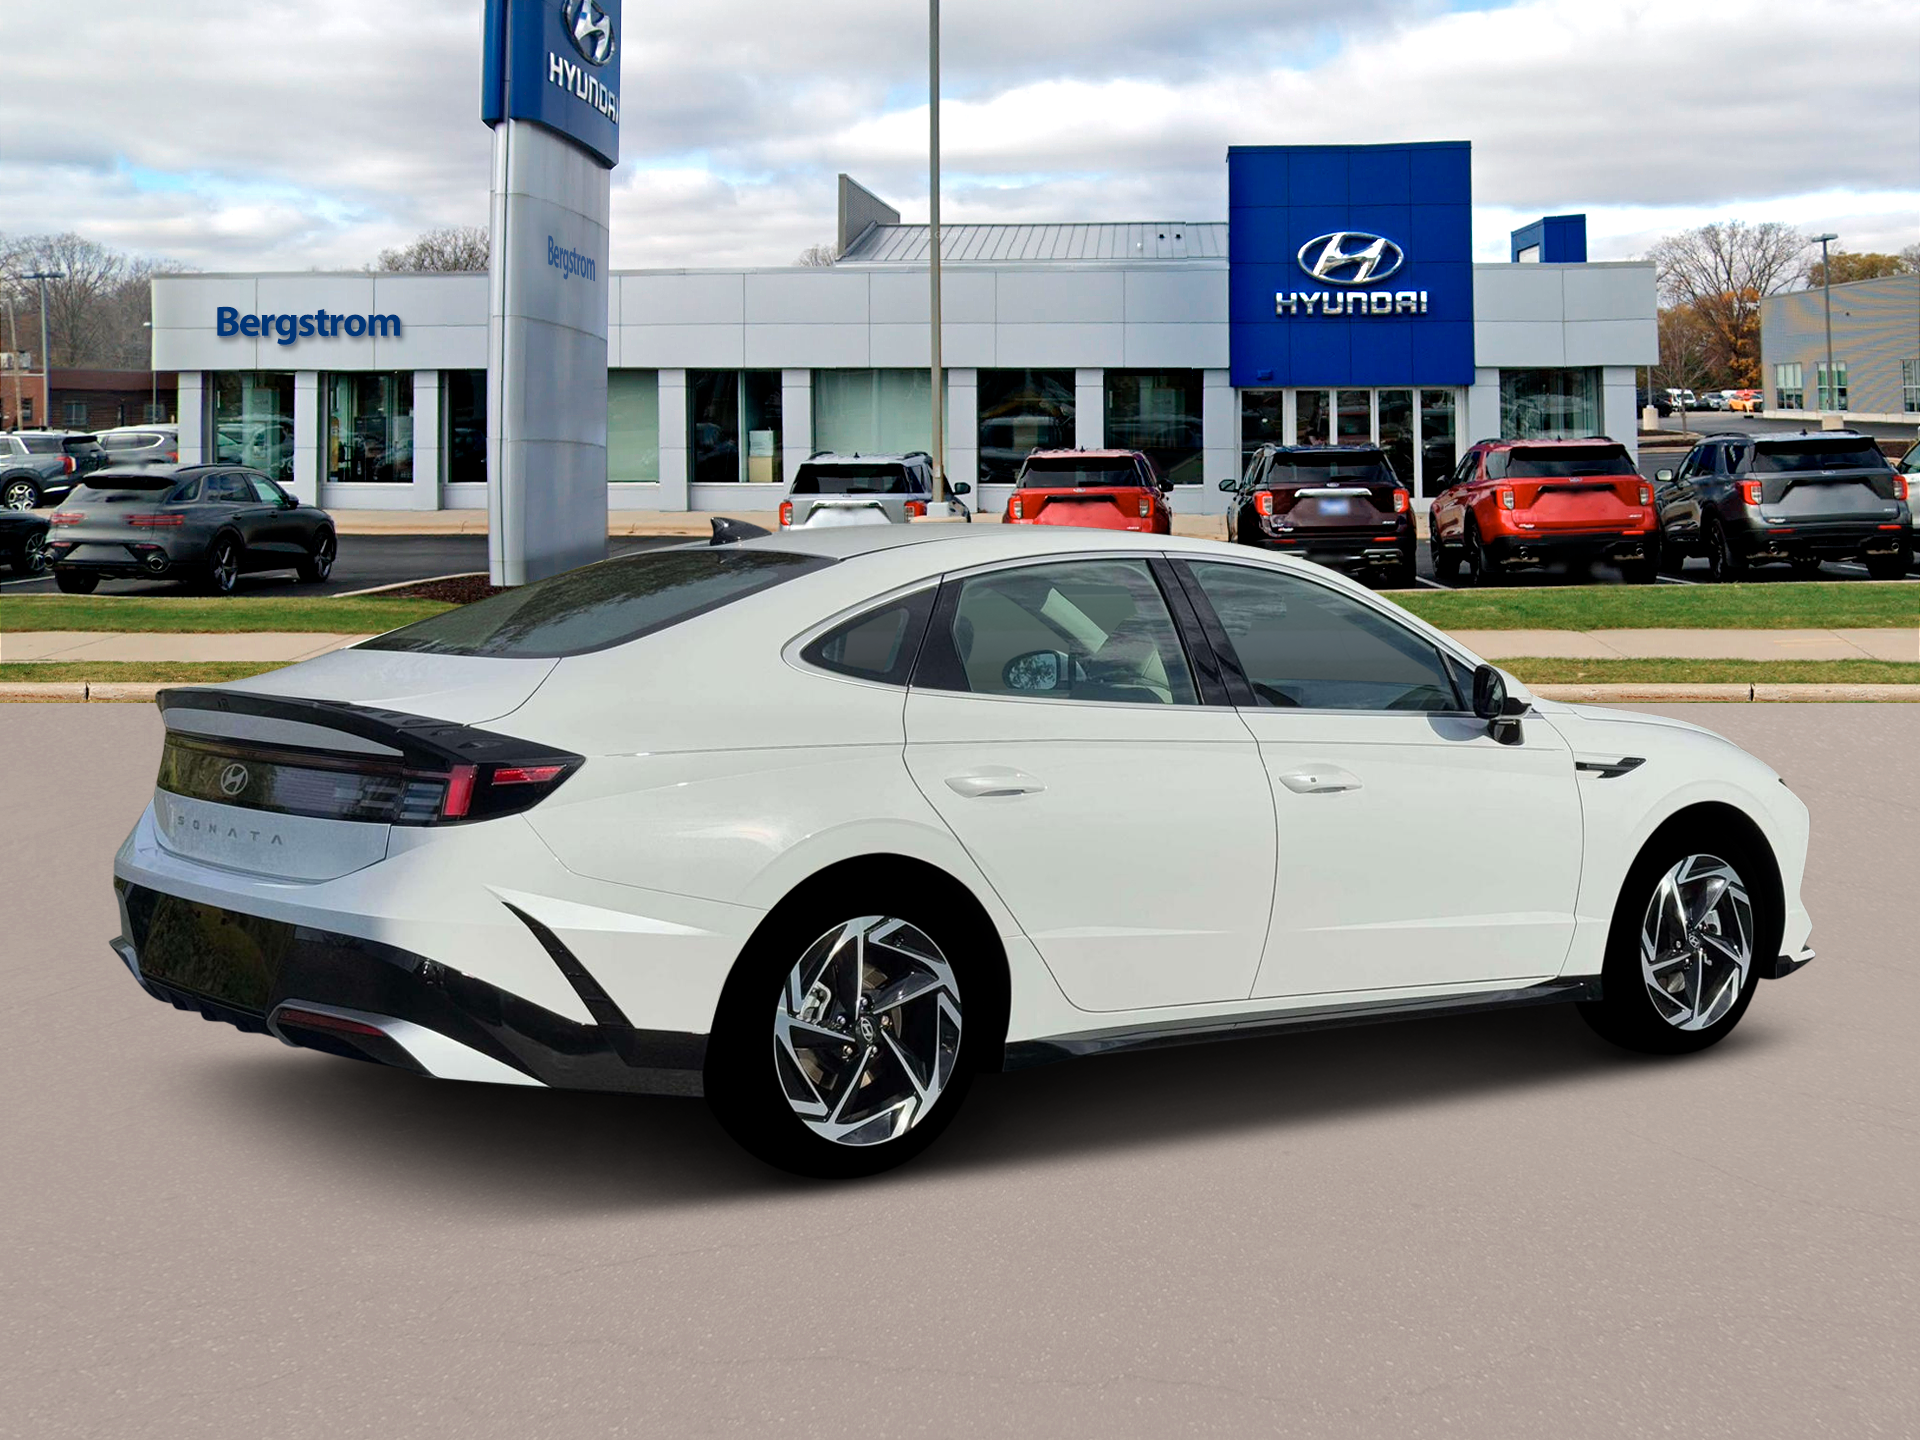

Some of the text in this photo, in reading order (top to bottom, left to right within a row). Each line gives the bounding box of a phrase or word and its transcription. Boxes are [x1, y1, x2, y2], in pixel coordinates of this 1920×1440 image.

[549, 52, 619, 124] HYUNDAI
[547, 235, 596, 282] Bergstrom
[1275, 291, 1428, 315] HYUNDAI
[216, 306, 401, 346] Bergstrom
[177, 816, 283, 846] SONATA
